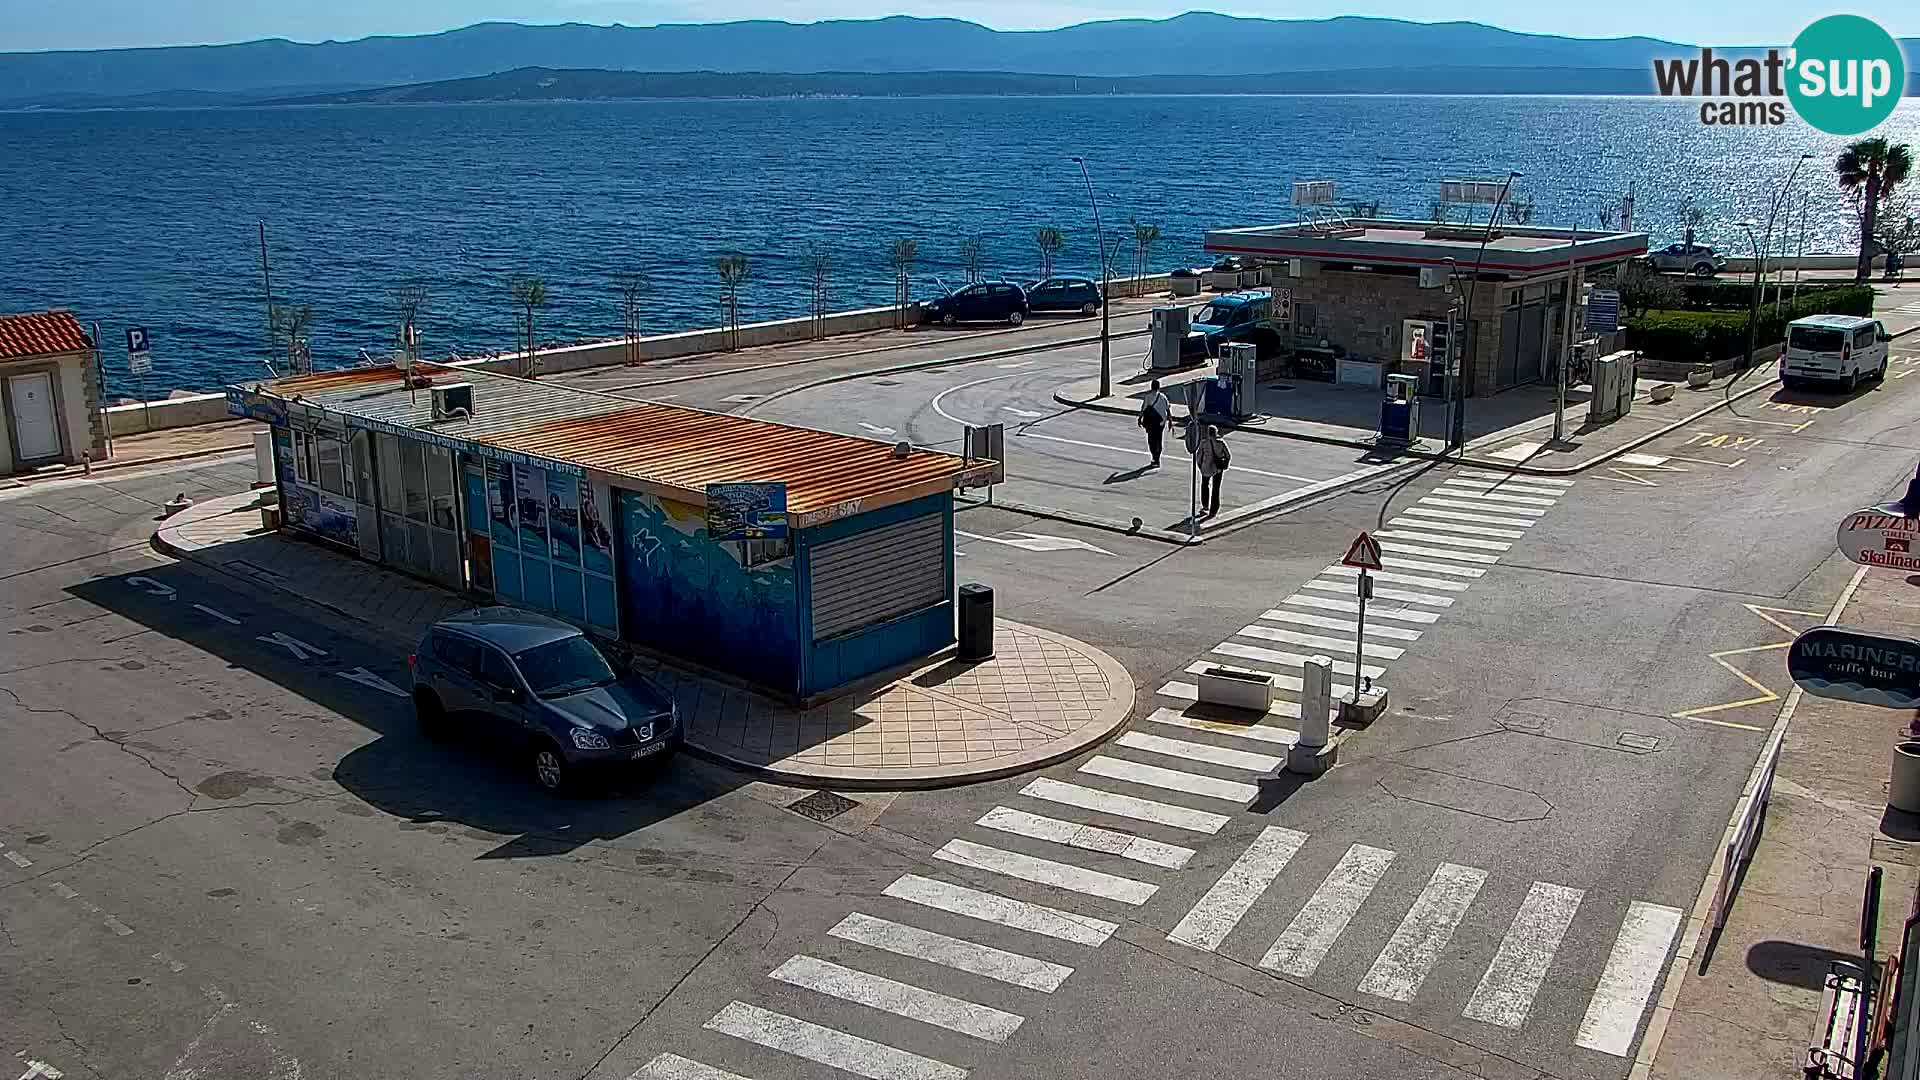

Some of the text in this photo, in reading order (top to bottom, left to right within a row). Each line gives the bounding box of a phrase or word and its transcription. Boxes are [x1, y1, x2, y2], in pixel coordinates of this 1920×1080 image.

[131, 331, 143, 348] P
[1684, 432, 1765, 451] TAXI
[495, 451, 526, 465] STATION
[529, 458, 553, 470] TICKET
[556, 464, 582, 476] OFFICE
[1848, 515, 1920, 533] PIZZE
[1870, 665, 1896, 680] bar
